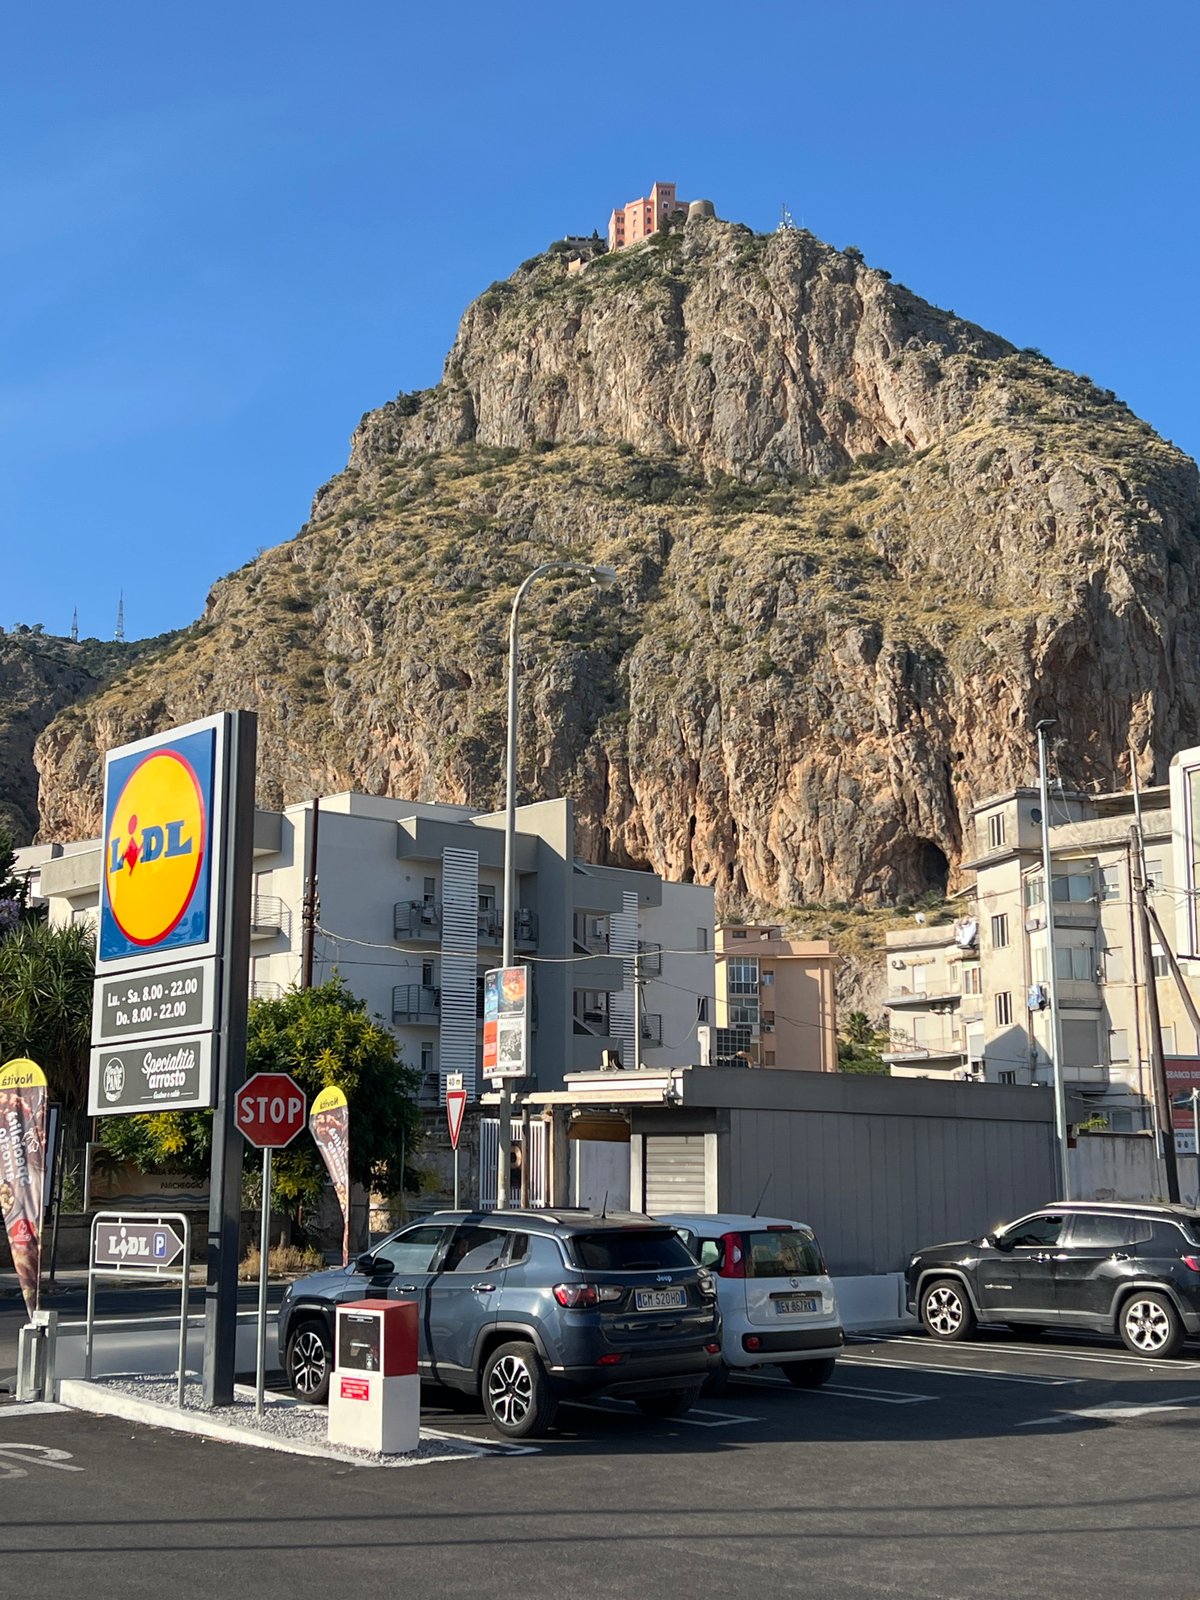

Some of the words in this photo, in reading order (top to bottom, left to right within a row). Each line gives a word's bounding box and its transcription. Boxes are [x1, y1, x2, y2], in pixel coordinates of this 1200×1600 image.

[107, 993, 120, 1007] Lu.
[127, 989, 140, 1004] Sa.
[142, 984, 163, 1001] 8.00
[170, 978, 198, 997] 22.00
[116, 1011, 130, 1026] Do.
[132, 1006, 152, 1023] 8.00
[160, 1001, 186, 1019] 22.00
[141, 1048, 195, 1080] Specialità
[149, 1071, 186, 1088] arrosto
[241, 1097, 302, 1124] STOP
[656, 1274, 672, 1283] Jeep
